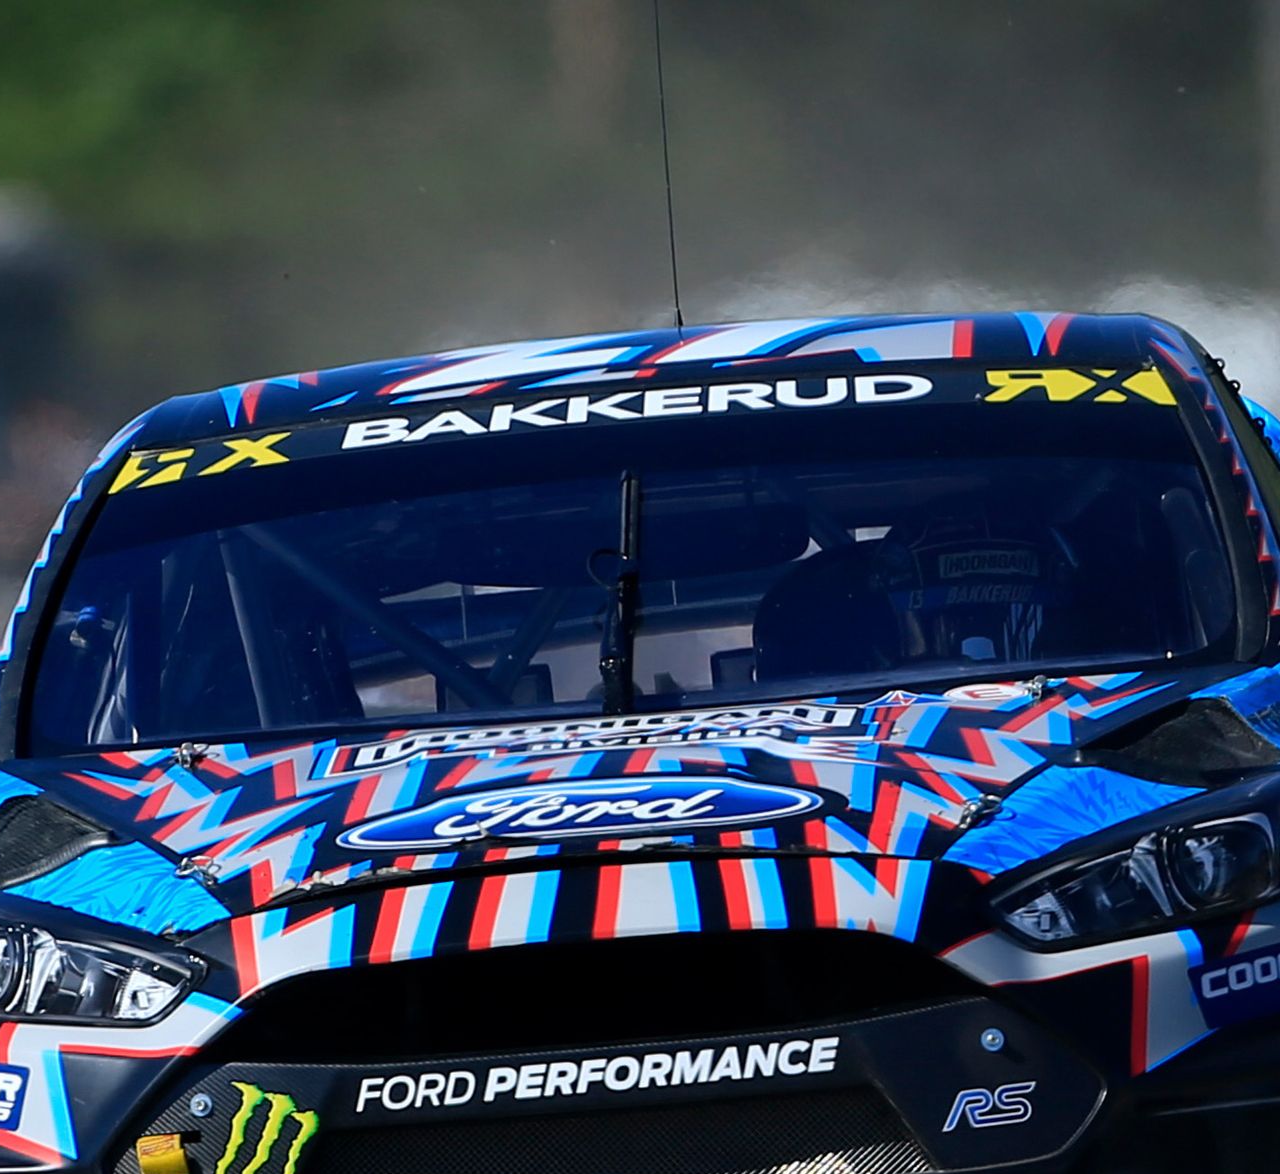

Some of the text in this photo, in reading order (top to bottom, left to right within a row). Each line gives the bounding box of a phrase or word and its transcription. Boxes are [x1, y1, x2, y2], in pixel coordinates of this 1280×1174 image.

[340, 373, 933, 450] BAKKERUD
[433, 785, 724, 836] Ford
[354, 1036, 840, 1113] FORD PERFORMANCE
[942, 1081, 1036, 1132] RS
